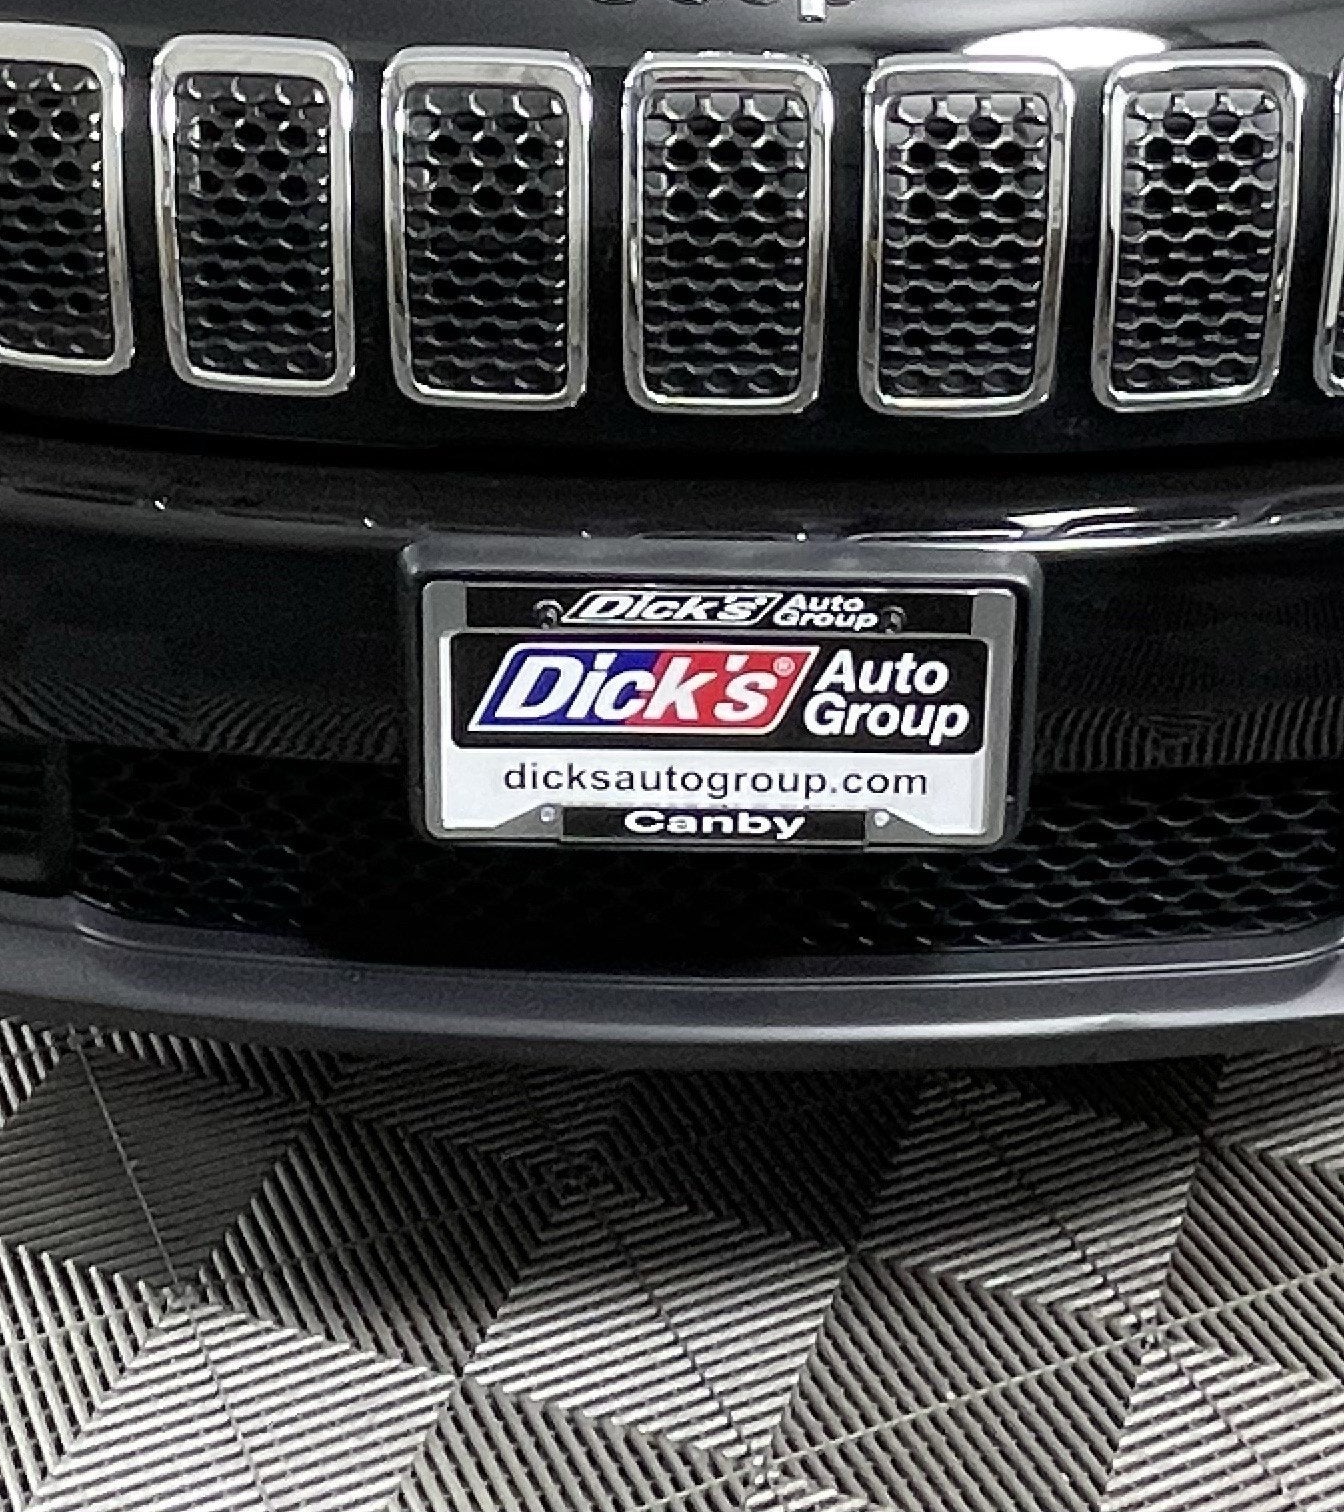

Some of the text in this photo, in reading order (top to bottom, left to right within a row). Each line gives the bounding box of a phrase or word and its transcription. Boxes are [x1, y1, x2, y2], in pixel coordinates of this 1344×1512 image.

[583, 591, 768, 621] Dick's
[783, 593, 865, 613] Auto
[773, 609, 879, 631] Group
[815, 650, 949, 694] Auto
[803, 691, 970, 746] Group
[503, 763, 928, 798] dicksautogroup.com
[623, 809, 807, 840] Canby
